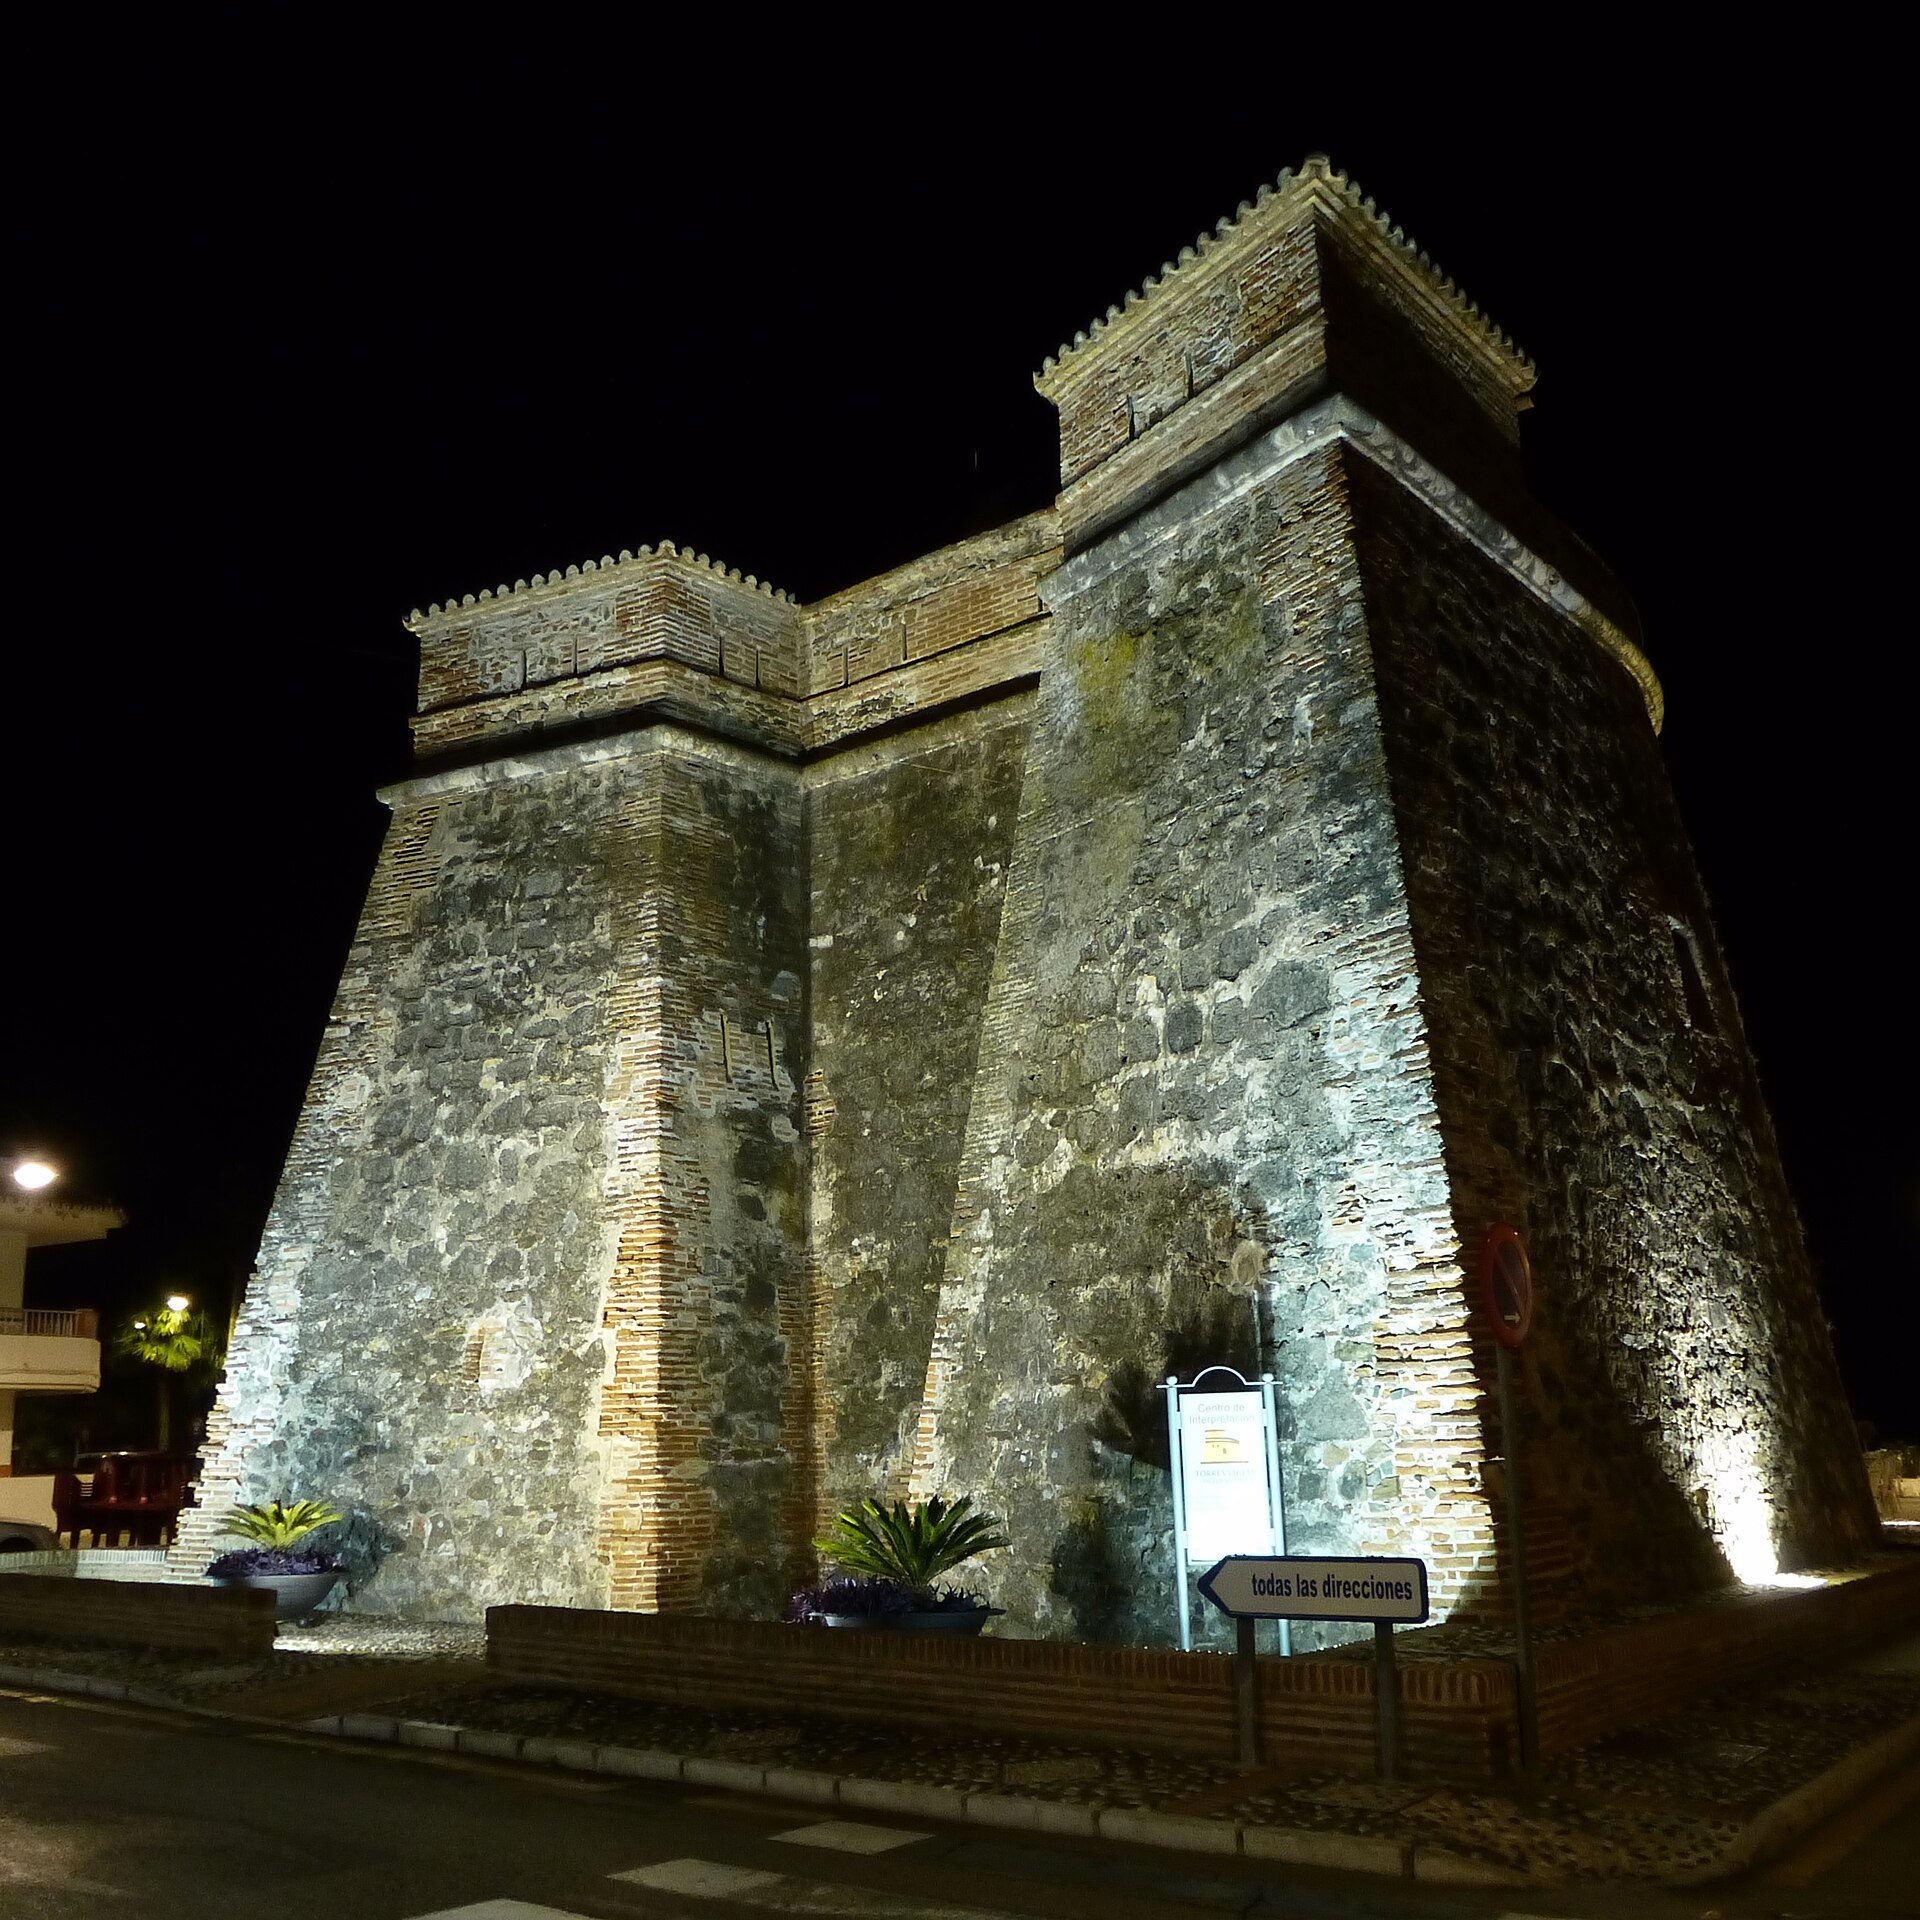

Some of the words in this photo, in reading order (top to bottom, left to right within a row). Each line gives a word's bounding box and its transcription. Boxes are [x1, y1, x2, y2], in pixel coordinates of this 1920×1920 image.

[1197, 1403, 1231, 1413] Centro
[1233, 1402, 1245, 1412] de
[1251, 1573, 1292, 1597] todas
[1296, 1573, 1318, 1598] las
[1322, 1573, 1413, 1601] direcciones
